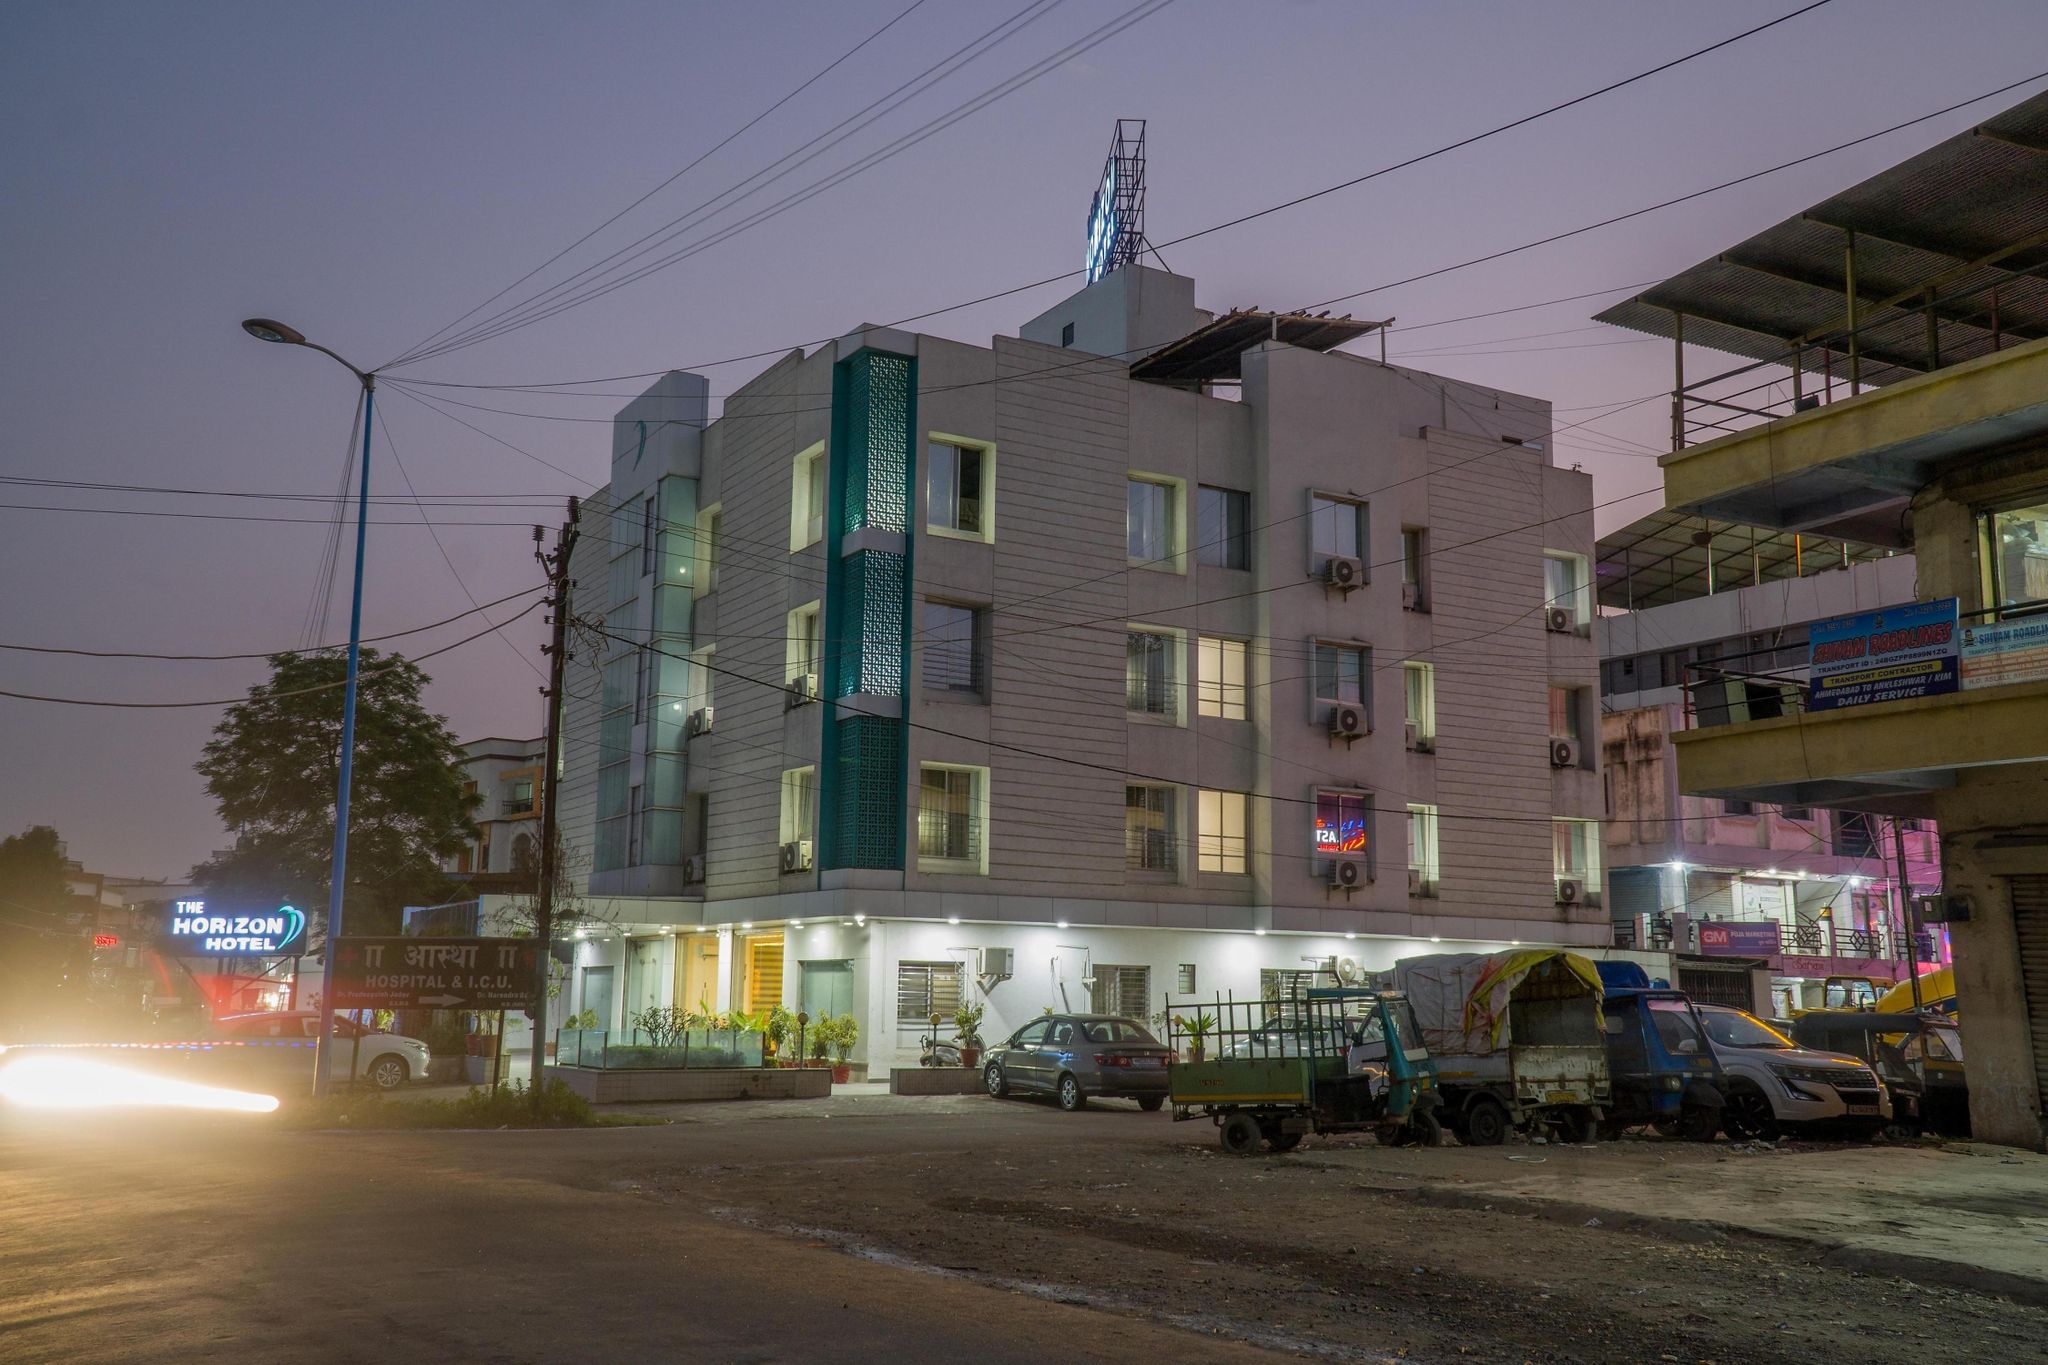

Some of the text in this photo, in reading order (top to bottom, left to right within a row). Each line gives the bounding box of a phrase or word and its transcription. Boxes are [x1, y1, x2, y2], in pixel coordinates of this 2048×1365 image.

[1868, 621, 1954, 656] ROADLINES
[1978, 629, 2010, 645] SHIVAM
[1818, 662, 1859, 674] TRANSPORT
[1830, 663, 1934, 685] TRANSPORT CONTRACTOR
[1815, 686, 1860, 699] AHMEDABAD
[1862, 684, 1872, 692] TO
[1873, 677, 1926, 692] ANKLESHWAR
[1934, 672, 1952, 683] KIM
[1837, 687, 1926, 707] DAILY SERVICE
[177, 901, 205, 914] THE
[173, 917, 284, 935] HORIZON
[205, 937, 276, 951] HOTEL
[366, 975, 512, 989] HOSPITAL & I.C.U.
